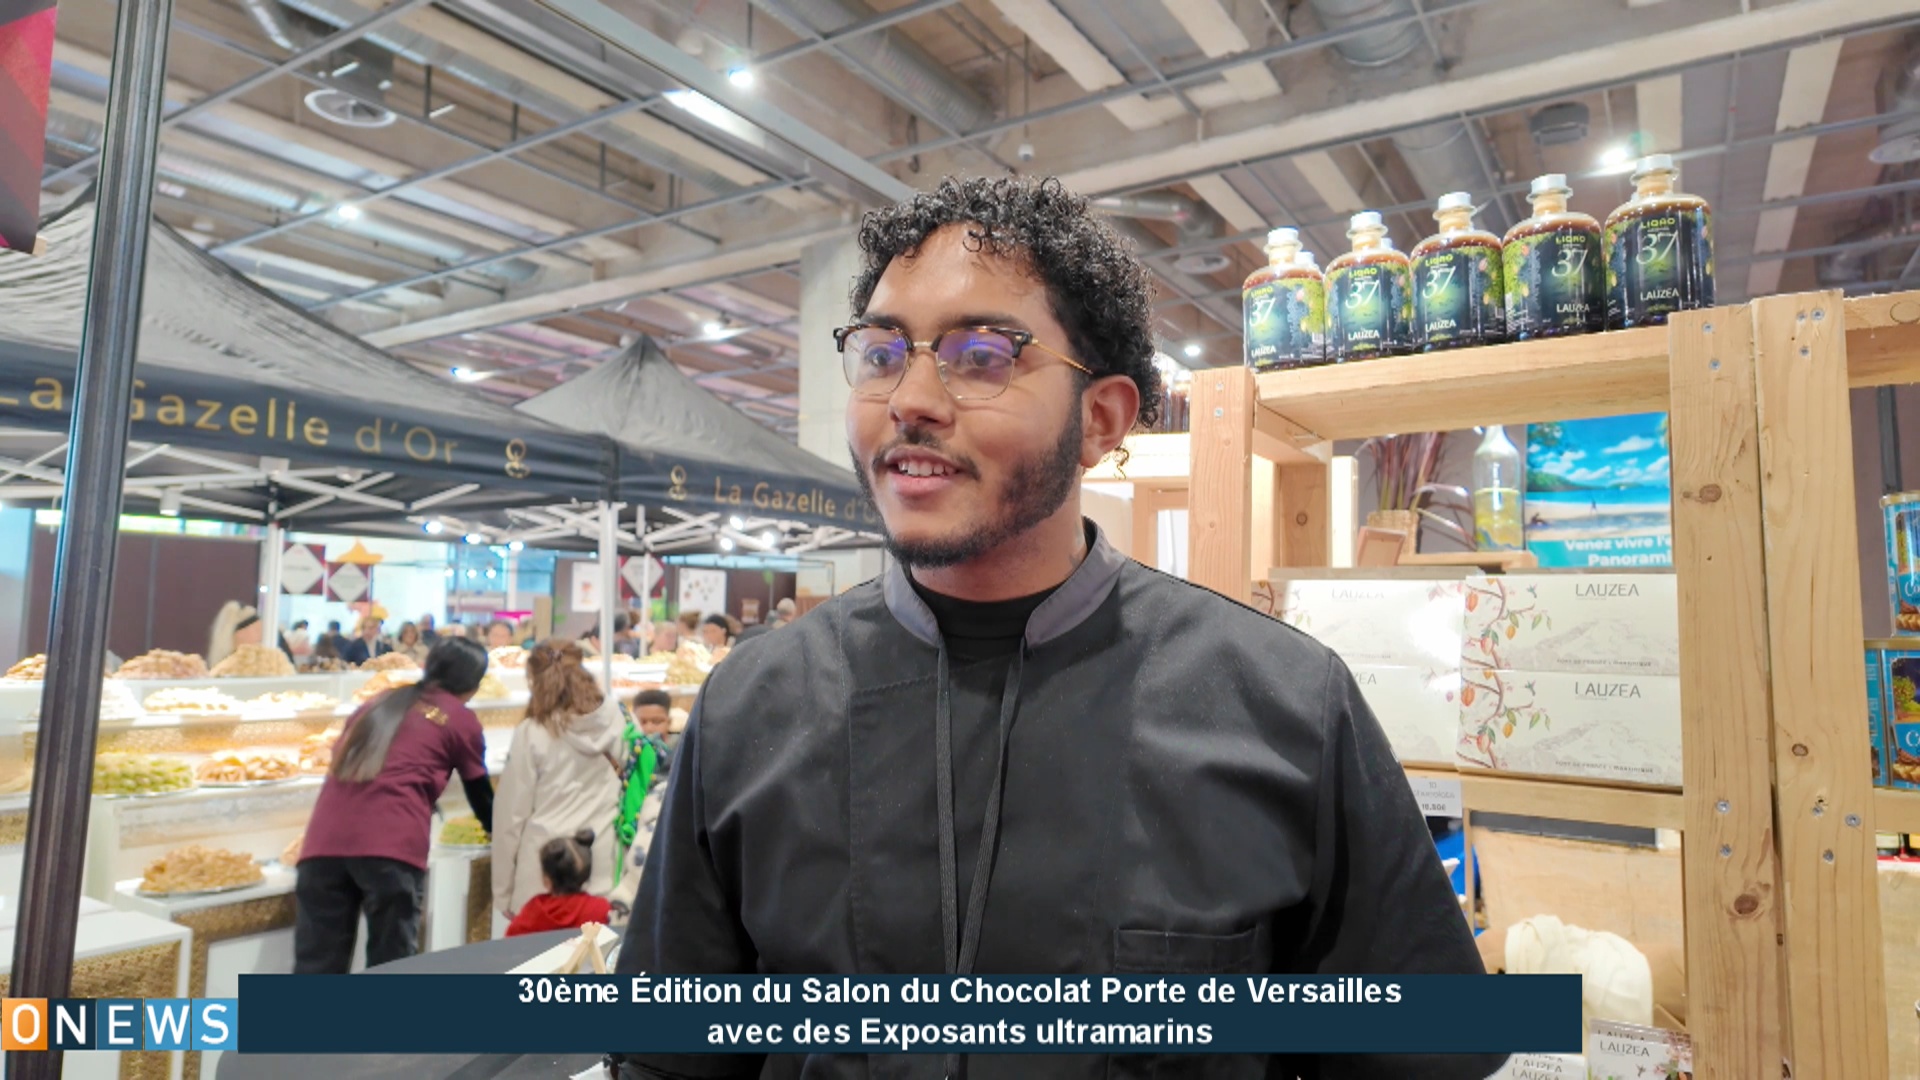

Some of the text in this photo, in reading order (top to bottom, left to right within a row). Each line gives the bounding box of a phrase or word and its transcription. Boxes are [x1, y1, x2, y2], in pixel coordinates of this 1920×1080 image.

[1636, 230, 1679, 265] 37
[1552, 249, 1588, 277] 37
[1345, 280, 1380, 310] 37
[1422, 266, 1456, 299] 37
[1249, 297, 1276, 327] 37
[0, 377, 63, 411] a
[355, 418, 459, 464] d'Or
[713, 476, 742, 505] La
[752, 482, 837, 518] Gazelle
[1564, 539, 1613, 551] Venez
[1615, 535, 1655, 550] vivre
[1575, 583, 1640, 598] LAUZEA
[1575, 682, 1641, 698] LAUZEA
[1600, 1039, 1650, 1057] LAUZEA
